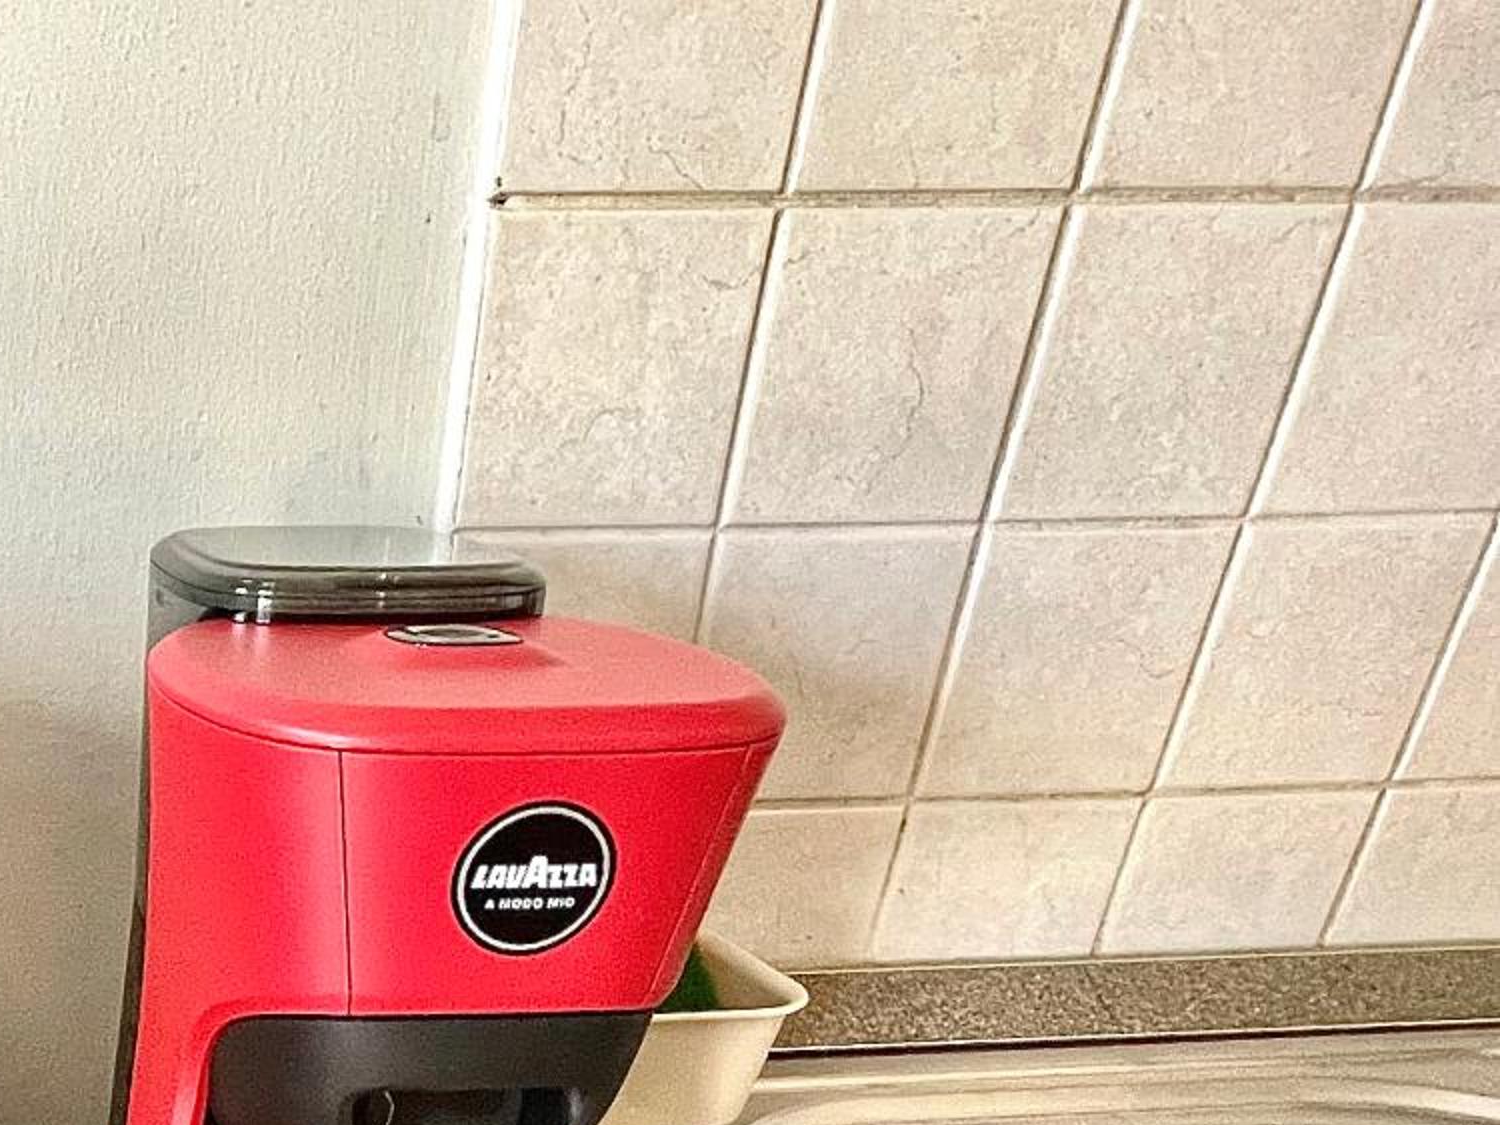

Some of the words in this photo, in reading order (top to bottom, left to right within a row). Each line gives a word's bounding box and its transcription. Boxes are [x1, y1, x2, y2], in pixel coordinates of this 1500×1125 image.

[470, 855, 597, 889] LAVAZZA
[484, 899, 494, 910] A
[499, 898, 543, 910] MODO
[547, 897, 576, 909] MIO
